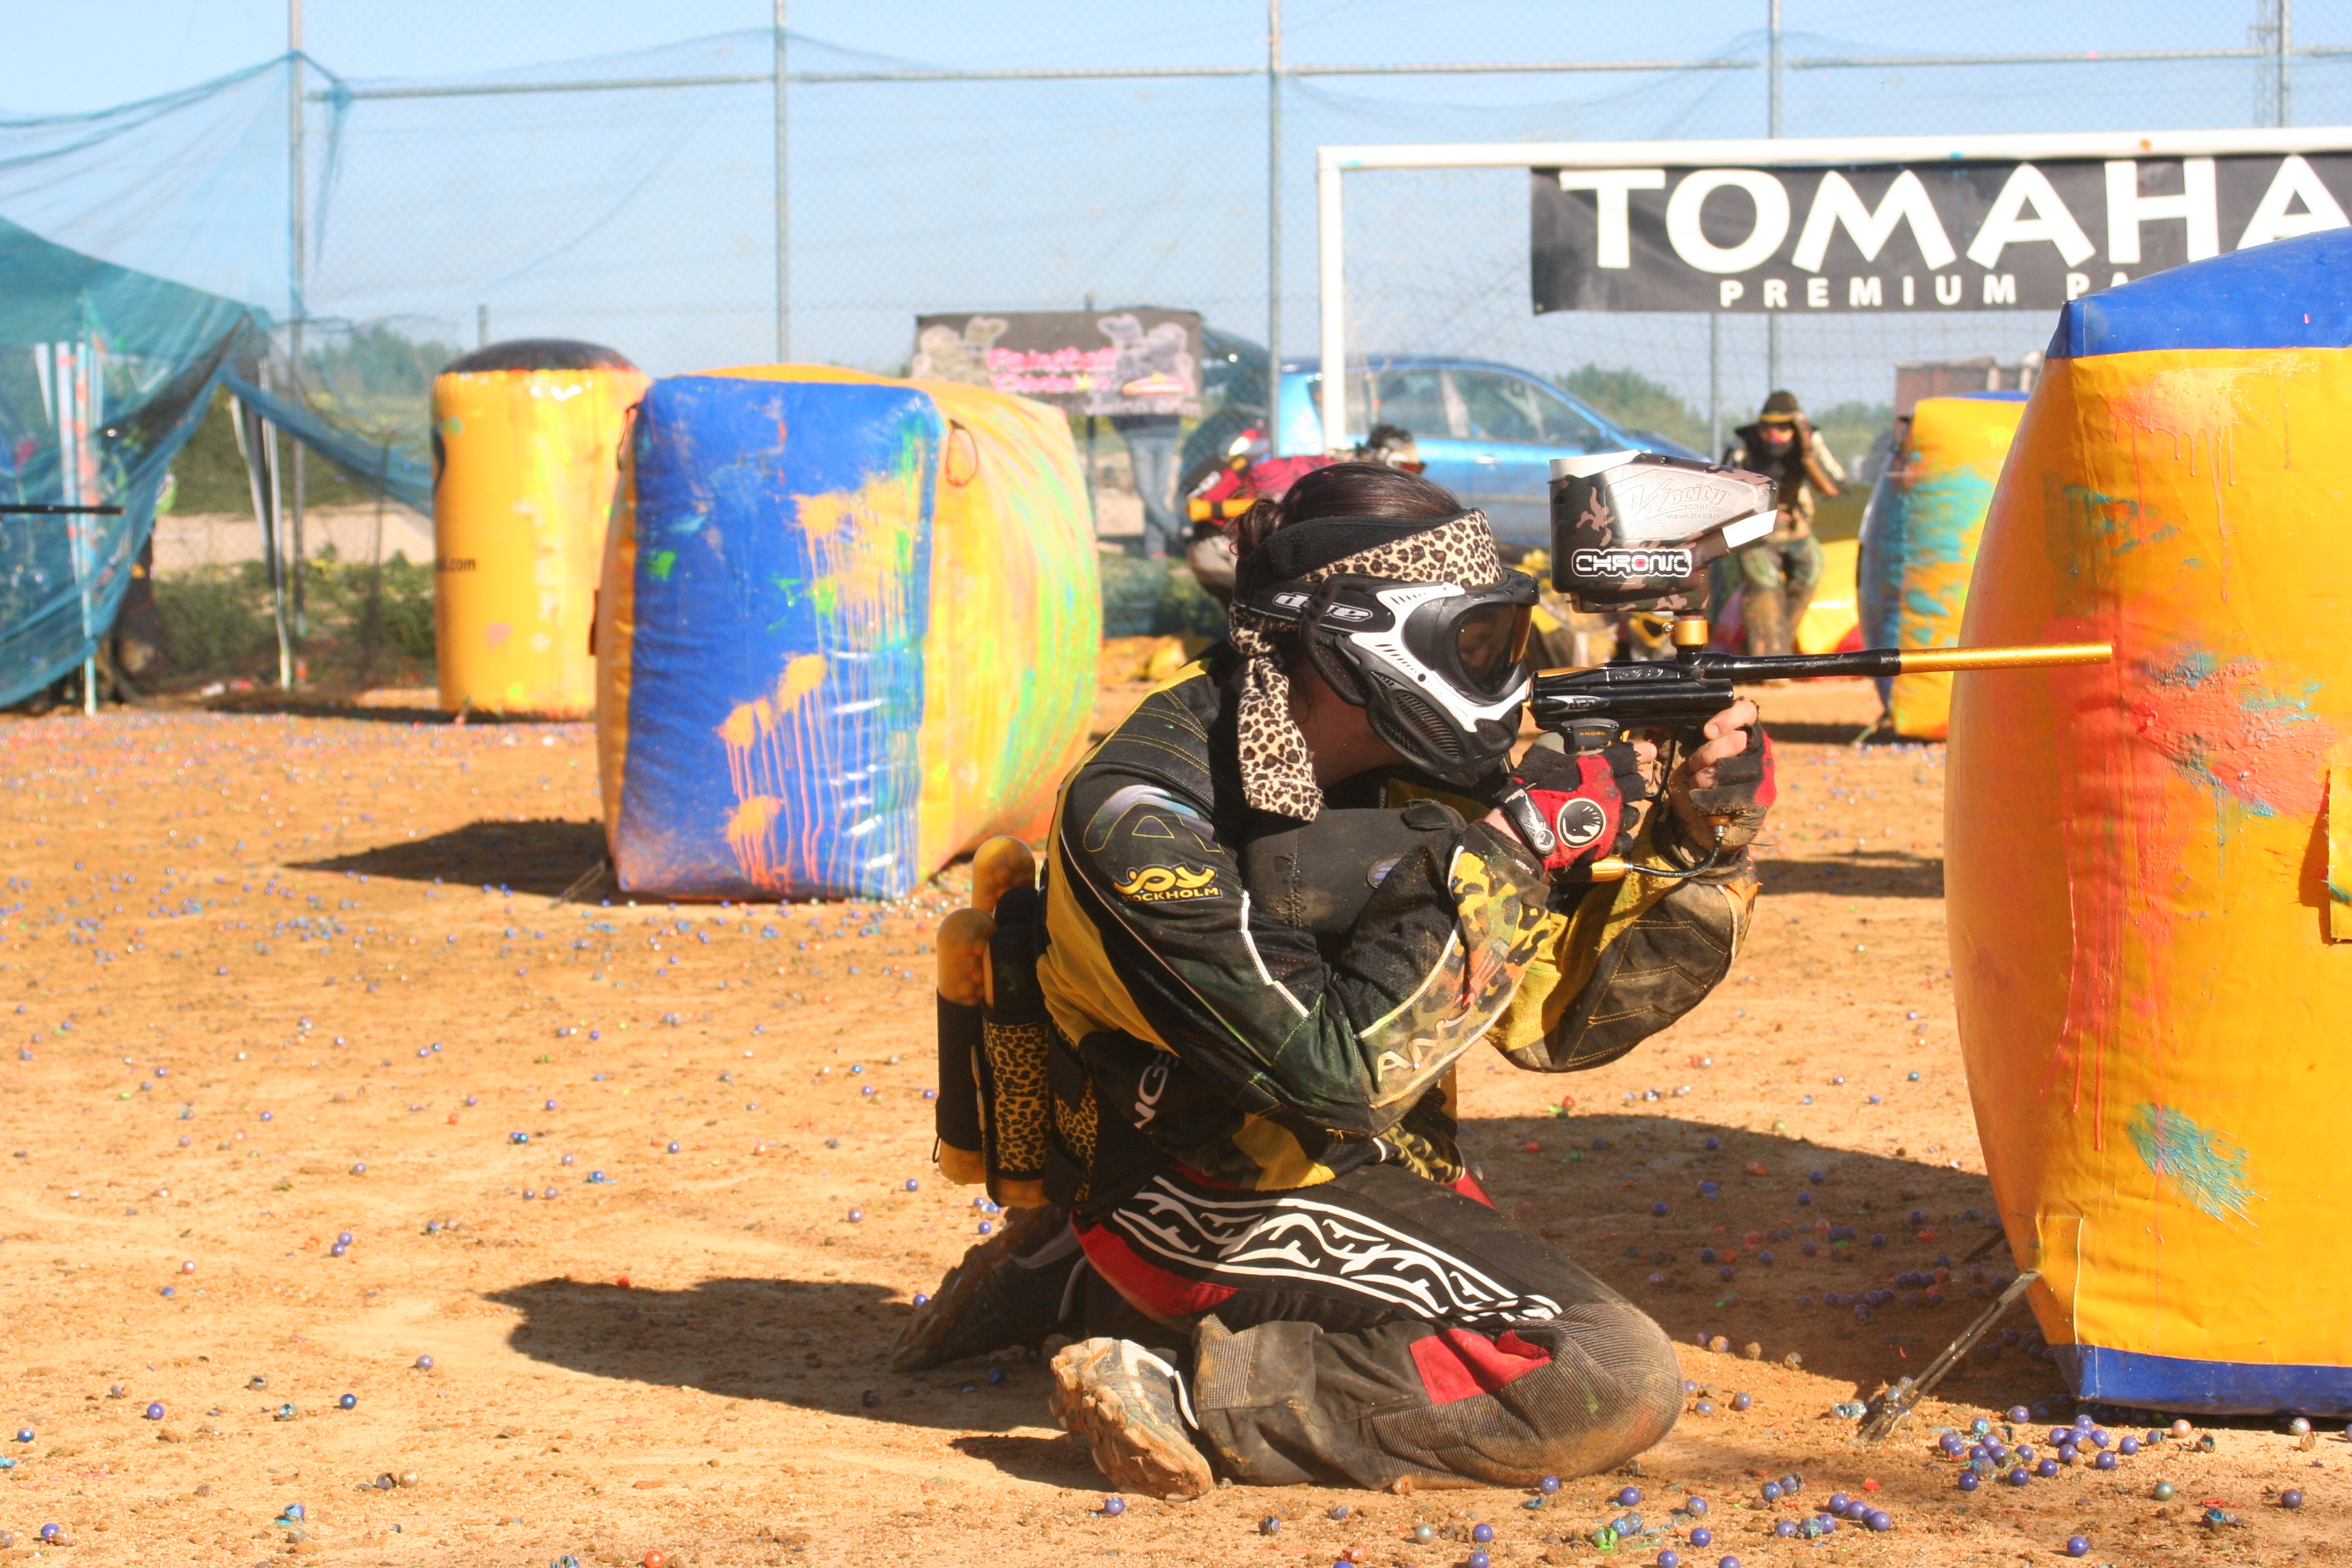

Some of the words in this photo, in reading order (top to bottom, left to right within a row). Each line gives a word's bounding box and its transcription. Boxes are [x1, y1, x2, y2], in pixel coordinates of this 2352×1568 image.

[1558, 154, 2351, 274] TOMAHA
[1719, 273, 2016, 308] PREMIUM
[1575, 555, 1688, 573] CHRONIC
[1274, 593, 1370, 620] de
[1122, 887, 1220, 902] STOCKHOLM
